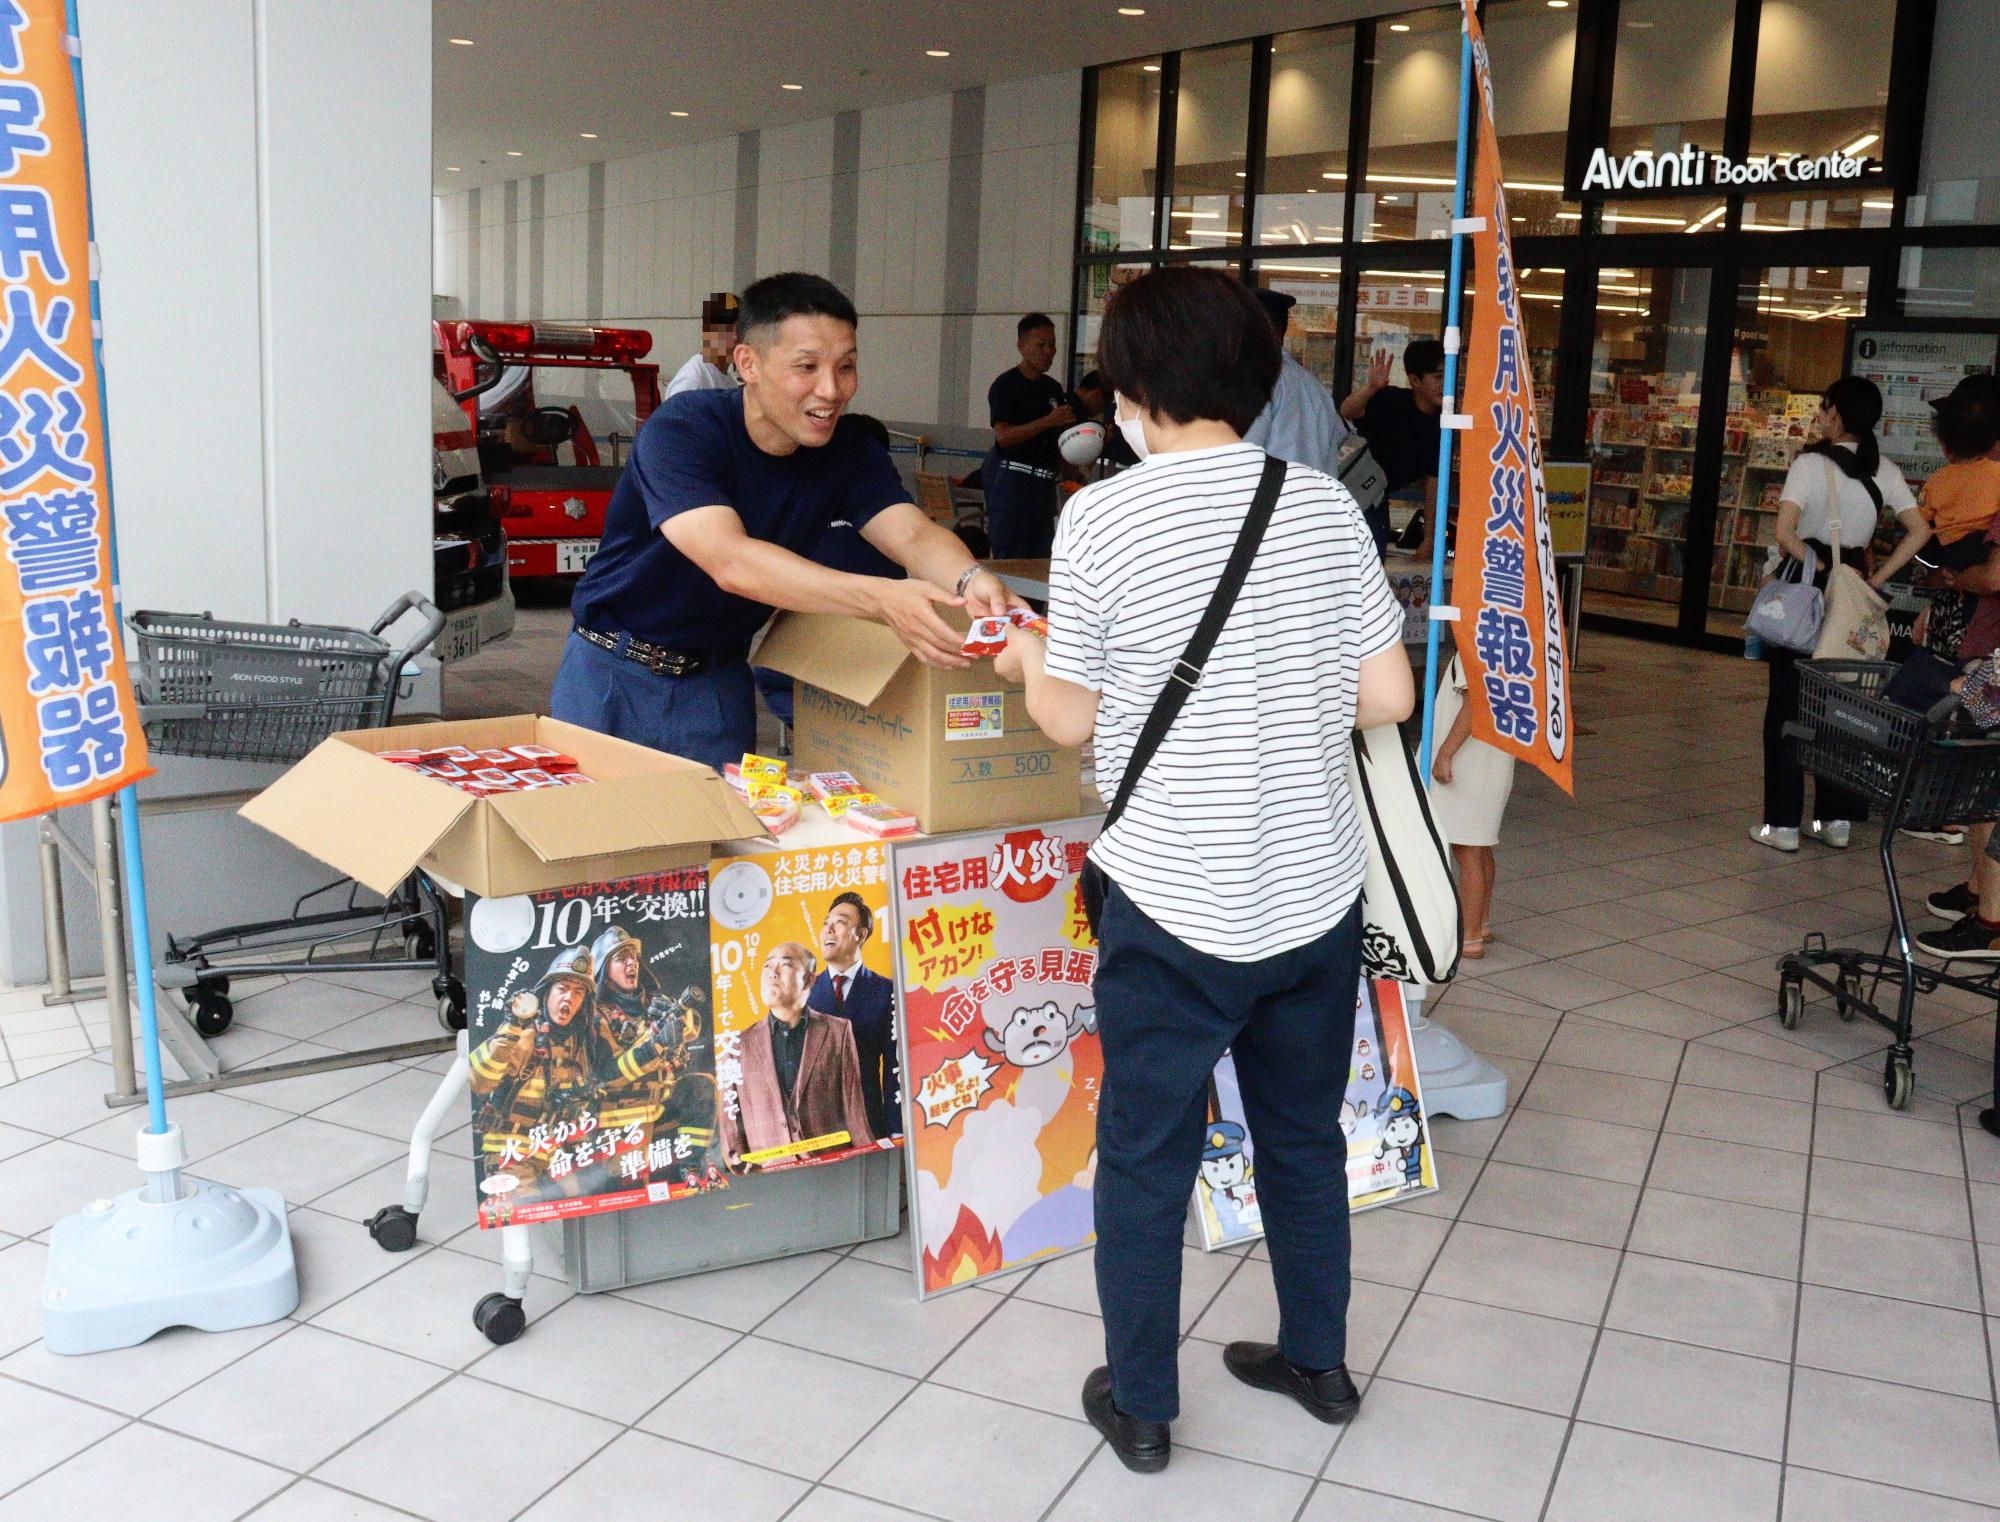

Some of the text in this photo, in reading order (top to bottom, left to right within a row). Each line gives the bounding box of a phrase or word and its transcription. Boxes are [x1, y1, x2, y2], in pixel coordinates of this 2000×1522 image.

[1582, 144, 1870, 191] Avanti Book Center
[1880, 341, 1947, 354] Information
[253, 674, 279, 684] FOOD
[280, 676, 304, 685] STYLE
[960, 753, 1052, 780] 入数 500
[774, 846, 886, 876] 火災から命を
[908, 907, 994, 957] 付けな
[499, 1111, 598, 1169] 火災から
[549, 1119, 647, 1179] 命を守る
[619, 1133, 694, 1181] 準備を
